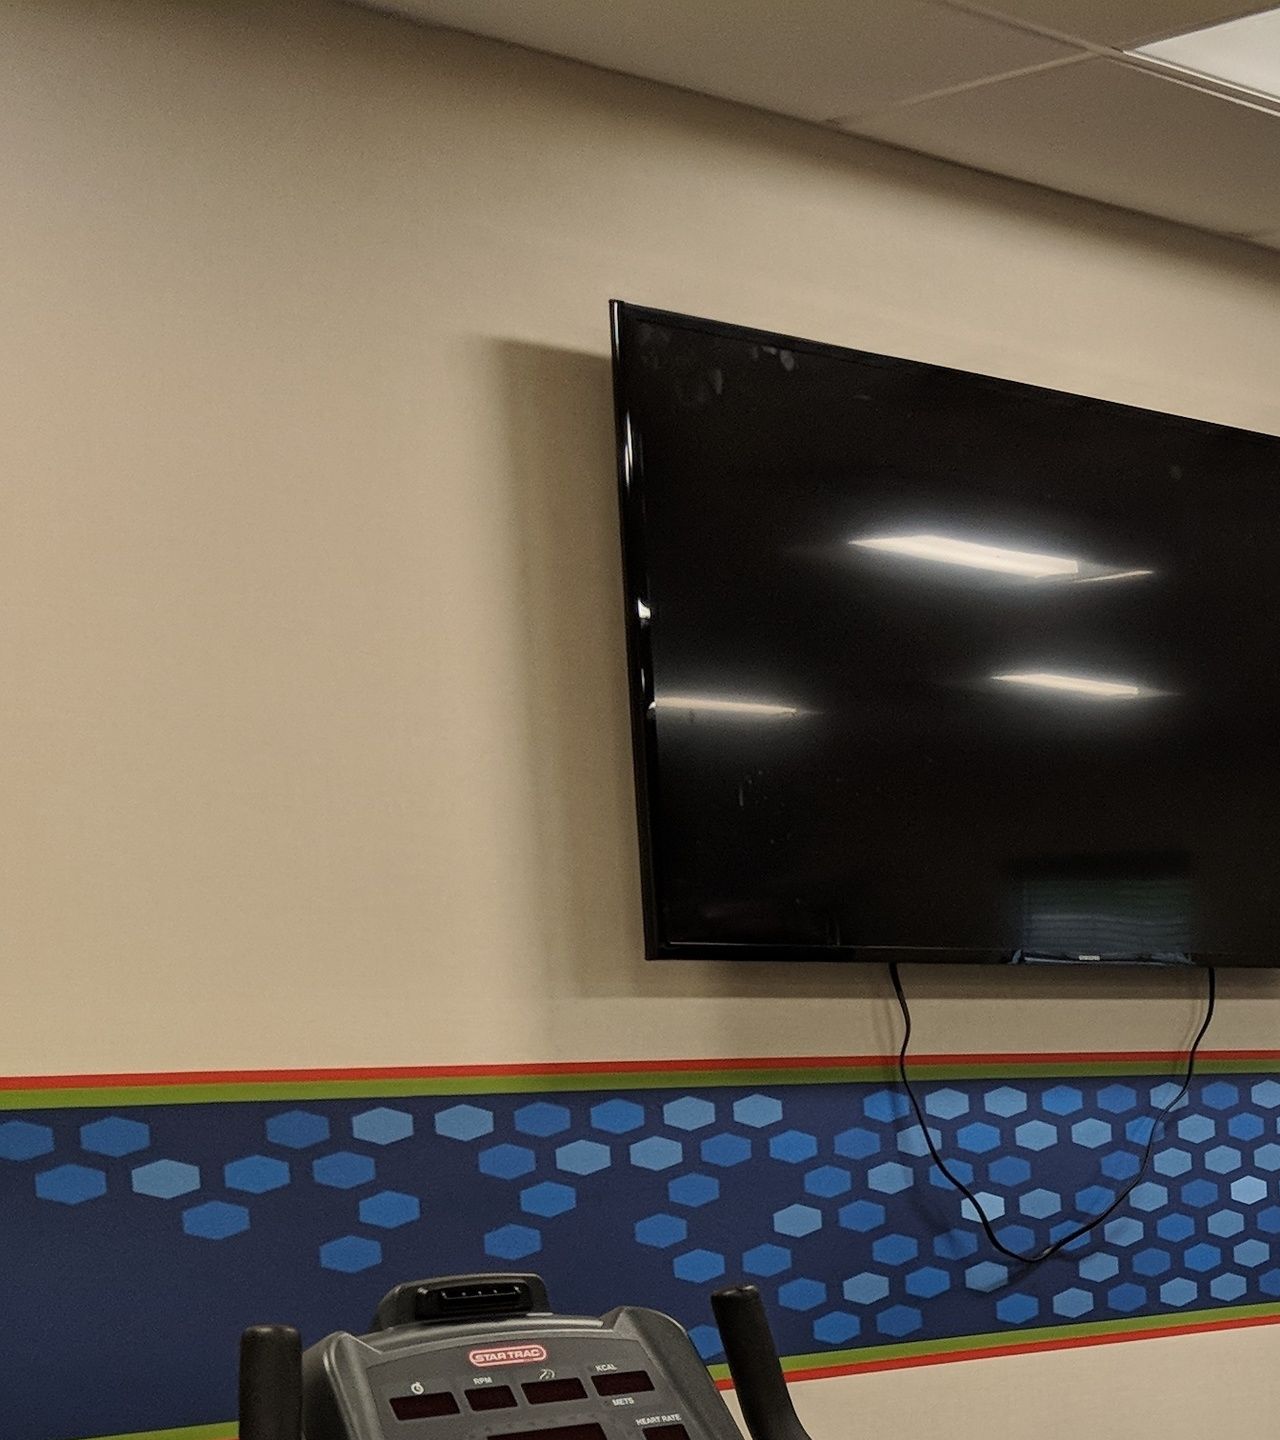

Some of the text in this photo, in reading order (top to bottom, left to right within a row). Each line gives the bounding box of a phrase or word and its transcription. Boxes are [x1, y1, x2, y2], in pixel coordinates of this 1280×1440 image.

[473, 1349, 541, 1363] STAR TRAC
[595, 1363, 618, 1372] KCAL
[473, 1376, 493, 1385] RPM
[611, 1397, 635, 1406] METS
[635, 1413, 682, 1426] HEART RATE
